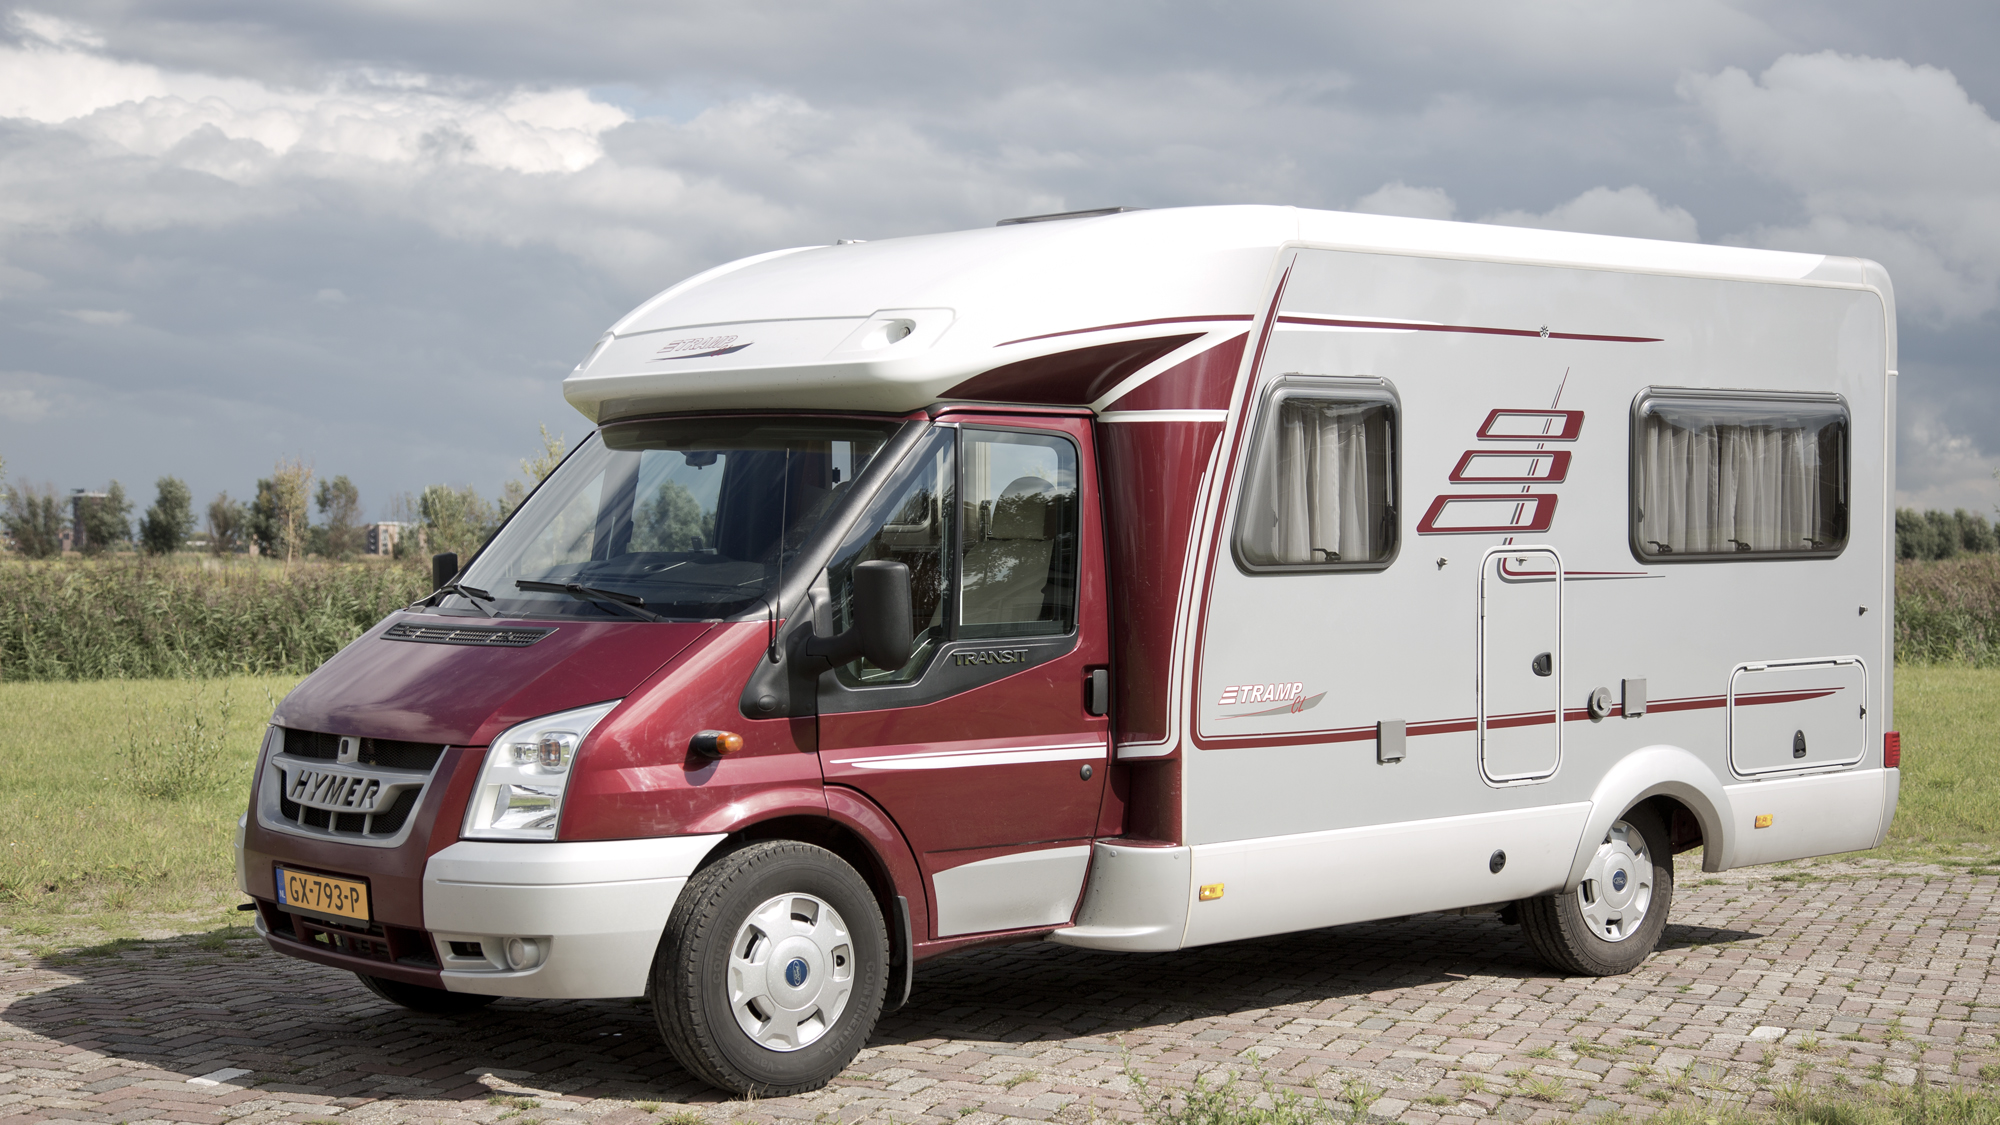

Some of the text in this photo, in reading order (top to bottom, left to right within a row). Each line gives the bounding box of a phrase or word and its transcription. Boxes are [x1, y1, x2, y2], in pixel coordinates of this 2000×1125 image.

[952, 649, 1029, 666] TRANSIT
[288, 769, 381, 809] HYMER
[279, 889, 286, 899] NL
[289, 875, 360, 913] GX-793-P
[825, 961, 876, 1056] CONTINENTAL
